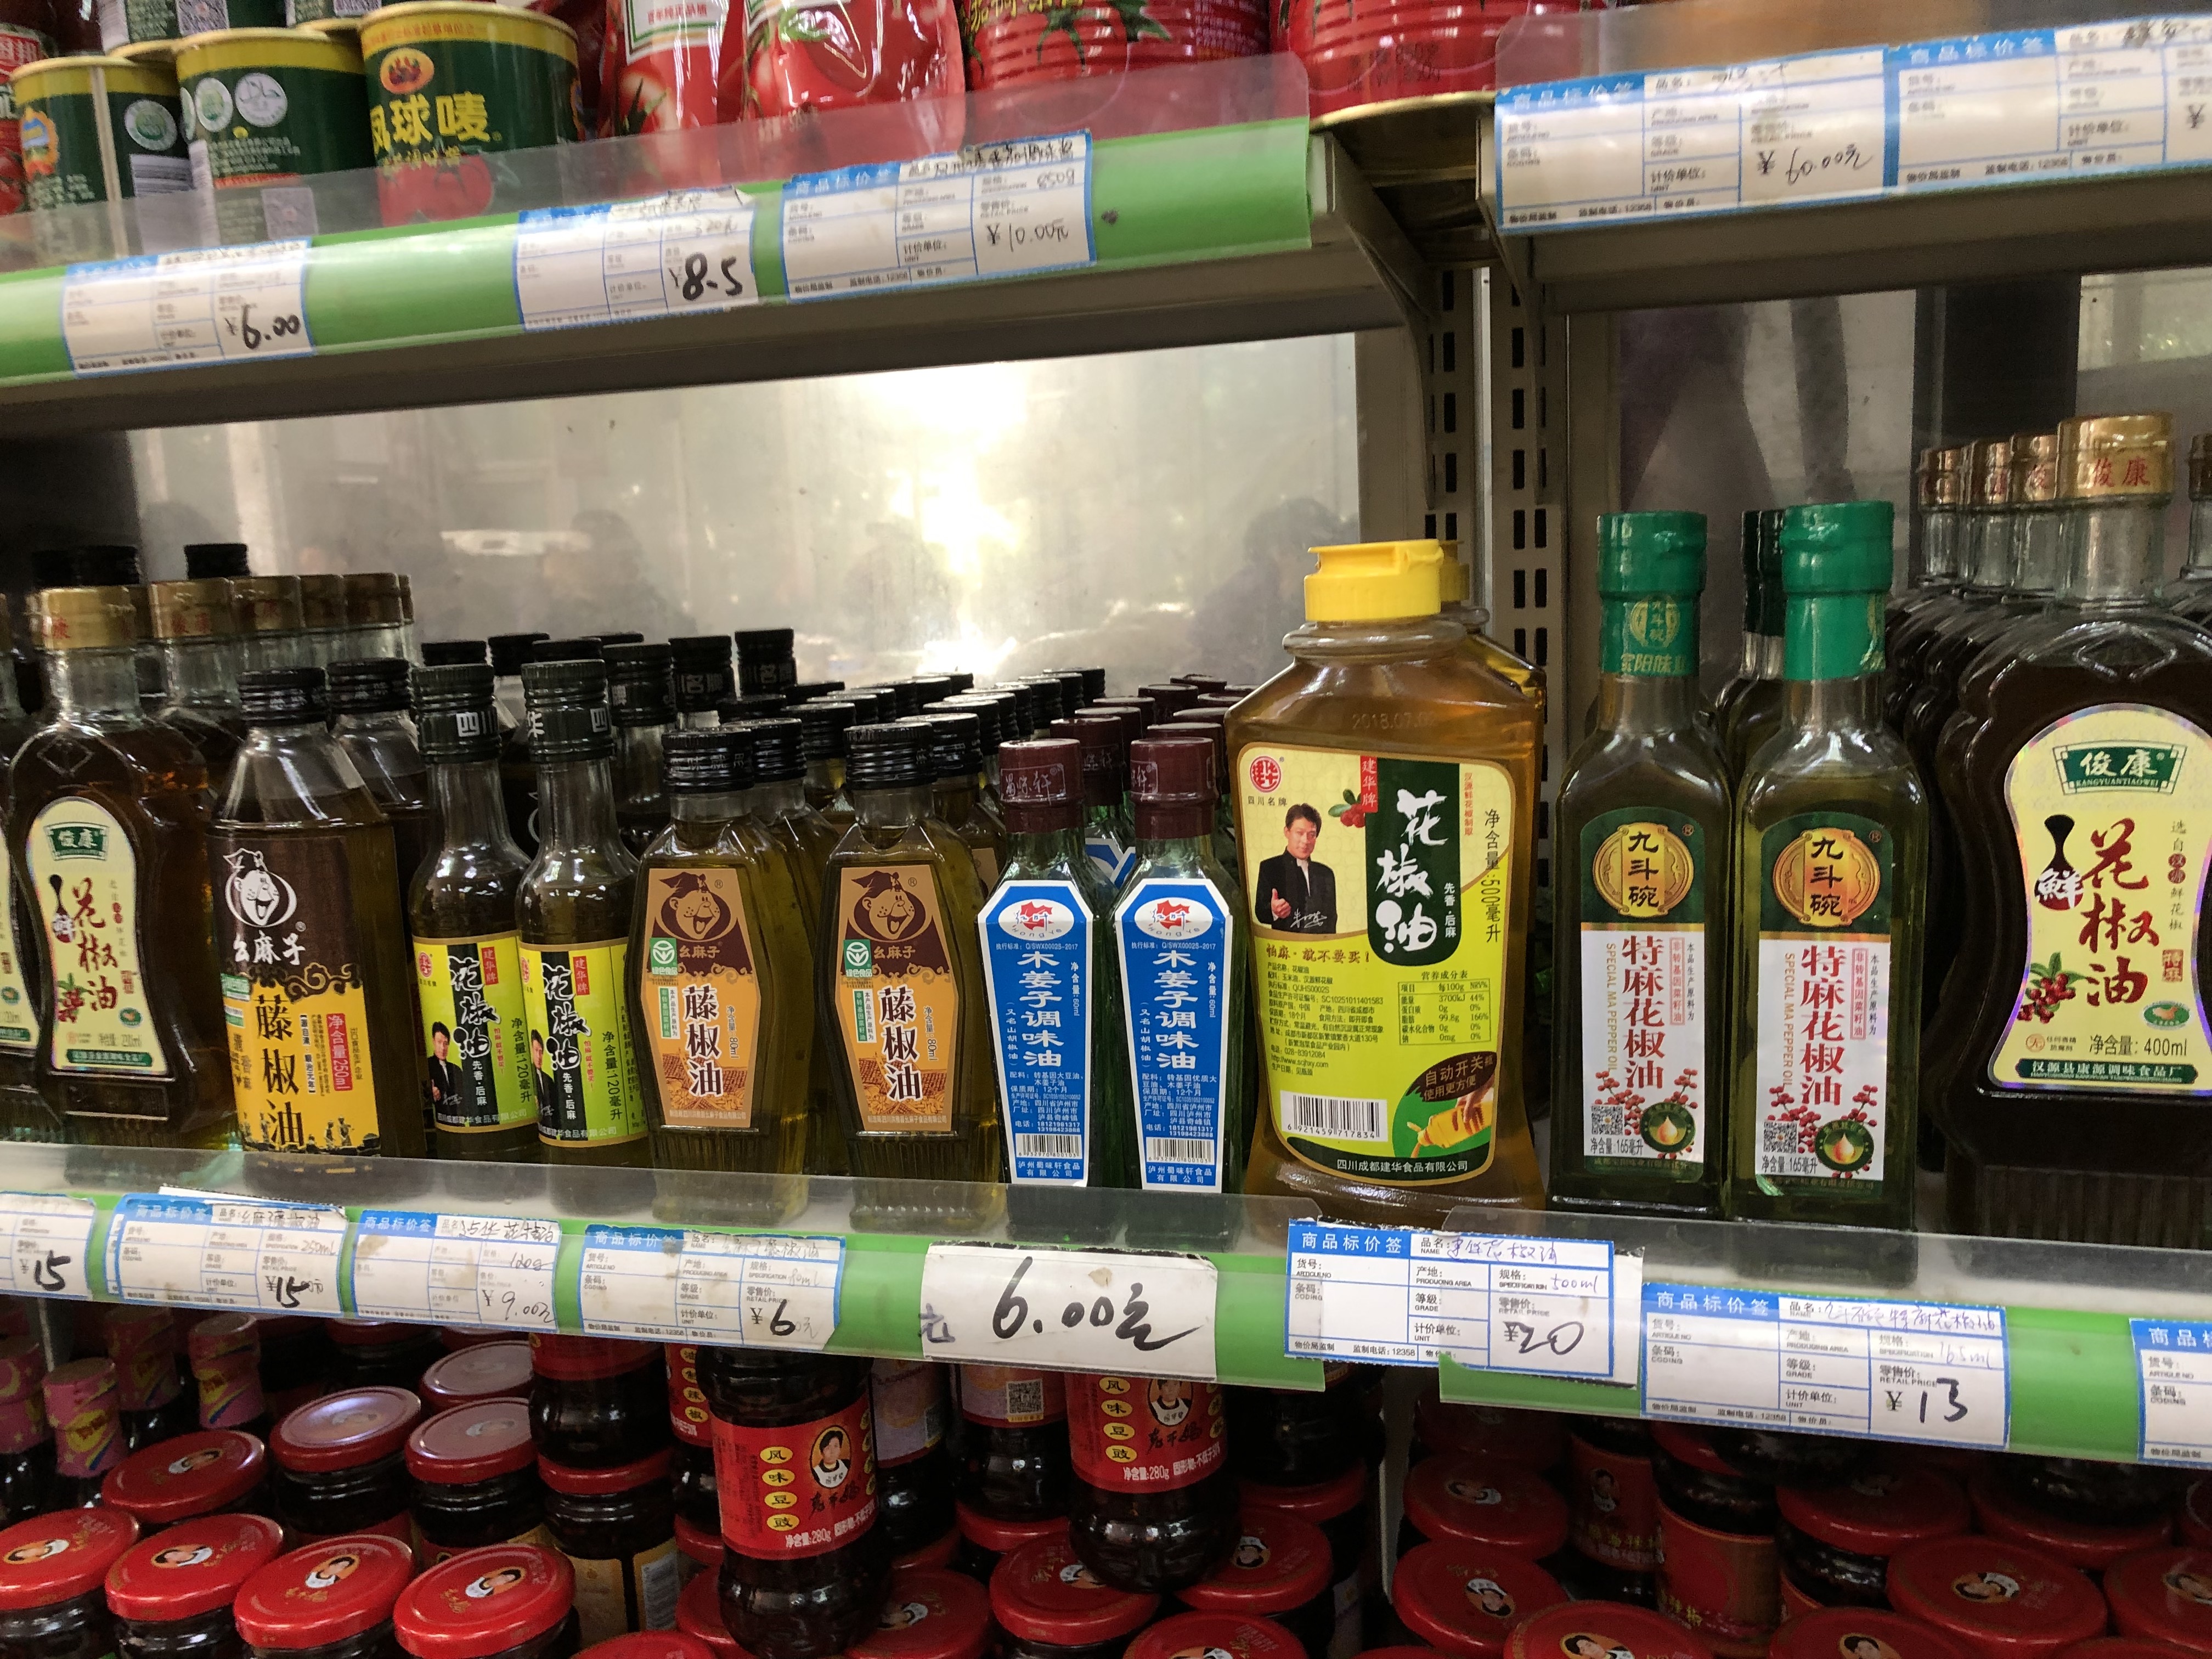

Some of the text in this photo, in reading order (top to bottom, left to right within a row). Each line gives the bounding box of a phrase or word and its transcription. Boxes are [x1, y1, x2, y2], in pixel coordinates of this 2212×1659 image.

[2092, 456, 2151, 488] 俊康
[2080, 748, 2158, 777] 俊康
[1361, 757, 1378, 807] 建华牌
[1248, 795, 1288, 807] 四川名牌
[1375, 788, 1449, 953] 花椒油
[1628, 831, 1660, 907] 九斗碗
[1809, 836, 1844, 917] 九斗碗
[2036, 868, 2084, 909] 鲜
[2079, 818, 2160, 1006] 花椒油
[72, 878, 118, 1011] 花椒油
[233, 930, 306, 965] 幺麻子
[680, 945, 720, 959] 幺麻子
[874, 945, 916, 960] 幺麻子
[483, 948, 498, 985] 建华牌
[575, 957, 589, 994] 建华牌
[1470, 994, 1485, 1002] 44%
[448, 955, 501, 1060] 花椒油
[1017, 951, 1064, 1067] 木姜子调味油
[1153, 950, 1199, 1070] 木姜子调味油
[1606, 943, 1618, 1071] SPECIAL MA PEPPER OIL
[1622, 935, 1665, 1089] 特麻花椒油
[541, 963, 591, 1070] 花椒油
[1782, 953, 1796, 1087] SPECIAL MA PEPPER OIL
[1470, 1023, 1481, 1031] 0%
[1799, 945, 1847, 1106] 特麻花椒油
[684, 985, 723, 1096] 藤椒油
[879, 986, 921, 1100] 藤椒油
[2090, 1034, 2187, 1056] 净含量: 400ml
[511, 1018, 532, 1103] 净含量:120毫升
[255, 994, 303, 1148] 藤椒油
[602, 1031, 623, 1120] 净含量:120毫升
[1297, 1125, 1333, 1136] 921459
[1338, 1128, 1375, 1139] 717834
[1018, 1161, 1080, 1170] 泸州蜀味轩食品
[1026, 1169, 1072, 1177] 有限公司
[1148, 1165, 1212, 1176] 泸州蜀味轩食品
[1337, 1159, 1469, 1173] 四川成都建华食品有限公司
[1156, 1175, 1204, 1183] 有限公司
[364, 1216, 431, 1233] 商品标价签
[1301, 1231, 1403, 1254] 商品标价签
[1421, 1237, 1451, 1249] 品名:
[750, 1261, 771, 1271] 规格:
[1297, 1257, 1323, 1270] 货号:
[585, 1274, 605, 1285] 条码:
[1417, 1266, 1443, 1278] 产地:
[1499, 1269, 1526, 1282] 规格:
[1296, 1282, 1321, 1295] 条码:
[1295, 1293, 1323, 1301] CODING
[1416, 1293, 1442, 1305] 等级:
[1499, 1297, 1536, 1310] 零售价:
[1656, 1291, 1770, 1316] 商品标价签
[1790, 1301, 1822, 1313] 品名:
[1414, 1323, 1460, 1336] 计价单位:
[1652, 1318, 1680, 1331] 货号:
[1295, 1341, 1335, 1352] 物价局监制
[1353, 1345, 1415, 1357] 监制电话:12358
[1652, 1345, 1680, 1358] 条码:
[1786, 1357, 1816, 1372] 等级:
[1879, 1364, 1921, 1379] 零售价:
[1786, 1371, 1813, 1379] GRADE
[1879, 1376, 1909, 1386] RETAIL
[1786, 1389, 1837, 1404] 计价单位:
[1786, 1401, 1803, 1409] UNIT
[1105, 1378, 1130, 1460] 风味豆豉
[1123, 1465, 1170, 1481] 净含量:280g
[767, 1449, 793, 1528] 风味豆豉
